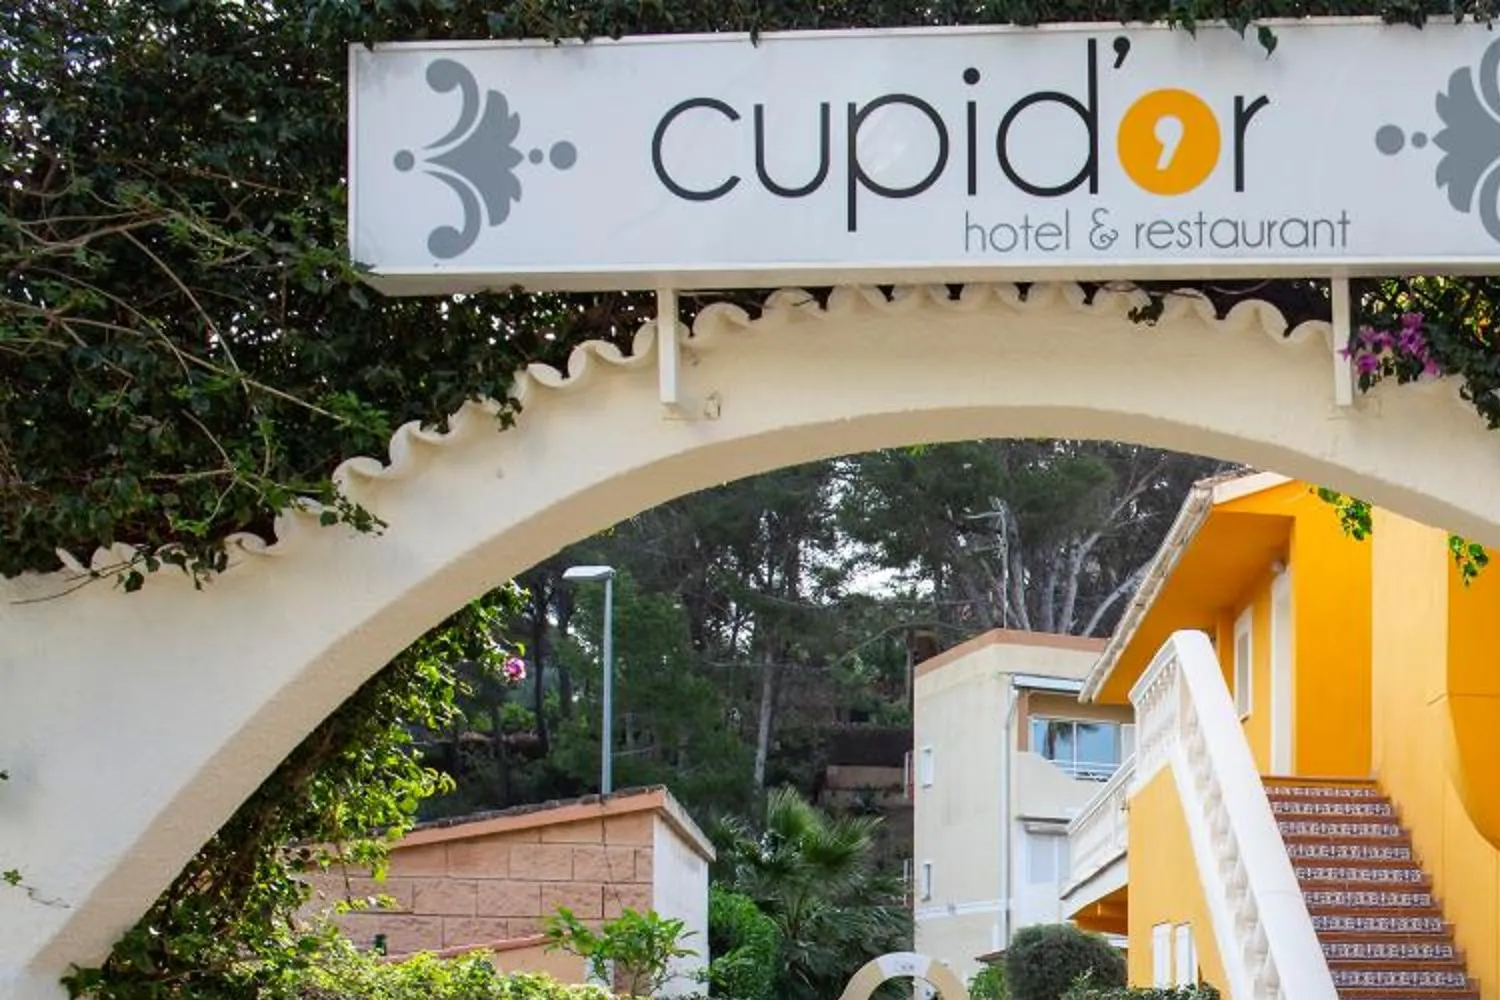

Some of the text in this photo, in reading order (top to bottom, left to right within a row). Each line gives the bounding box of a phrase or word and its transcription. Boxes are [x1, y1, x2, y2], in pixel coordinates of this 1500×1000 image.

[651, 37, 1270, 232] cupid'or
[964, 207, 1351, 253] hotel & restaurant
